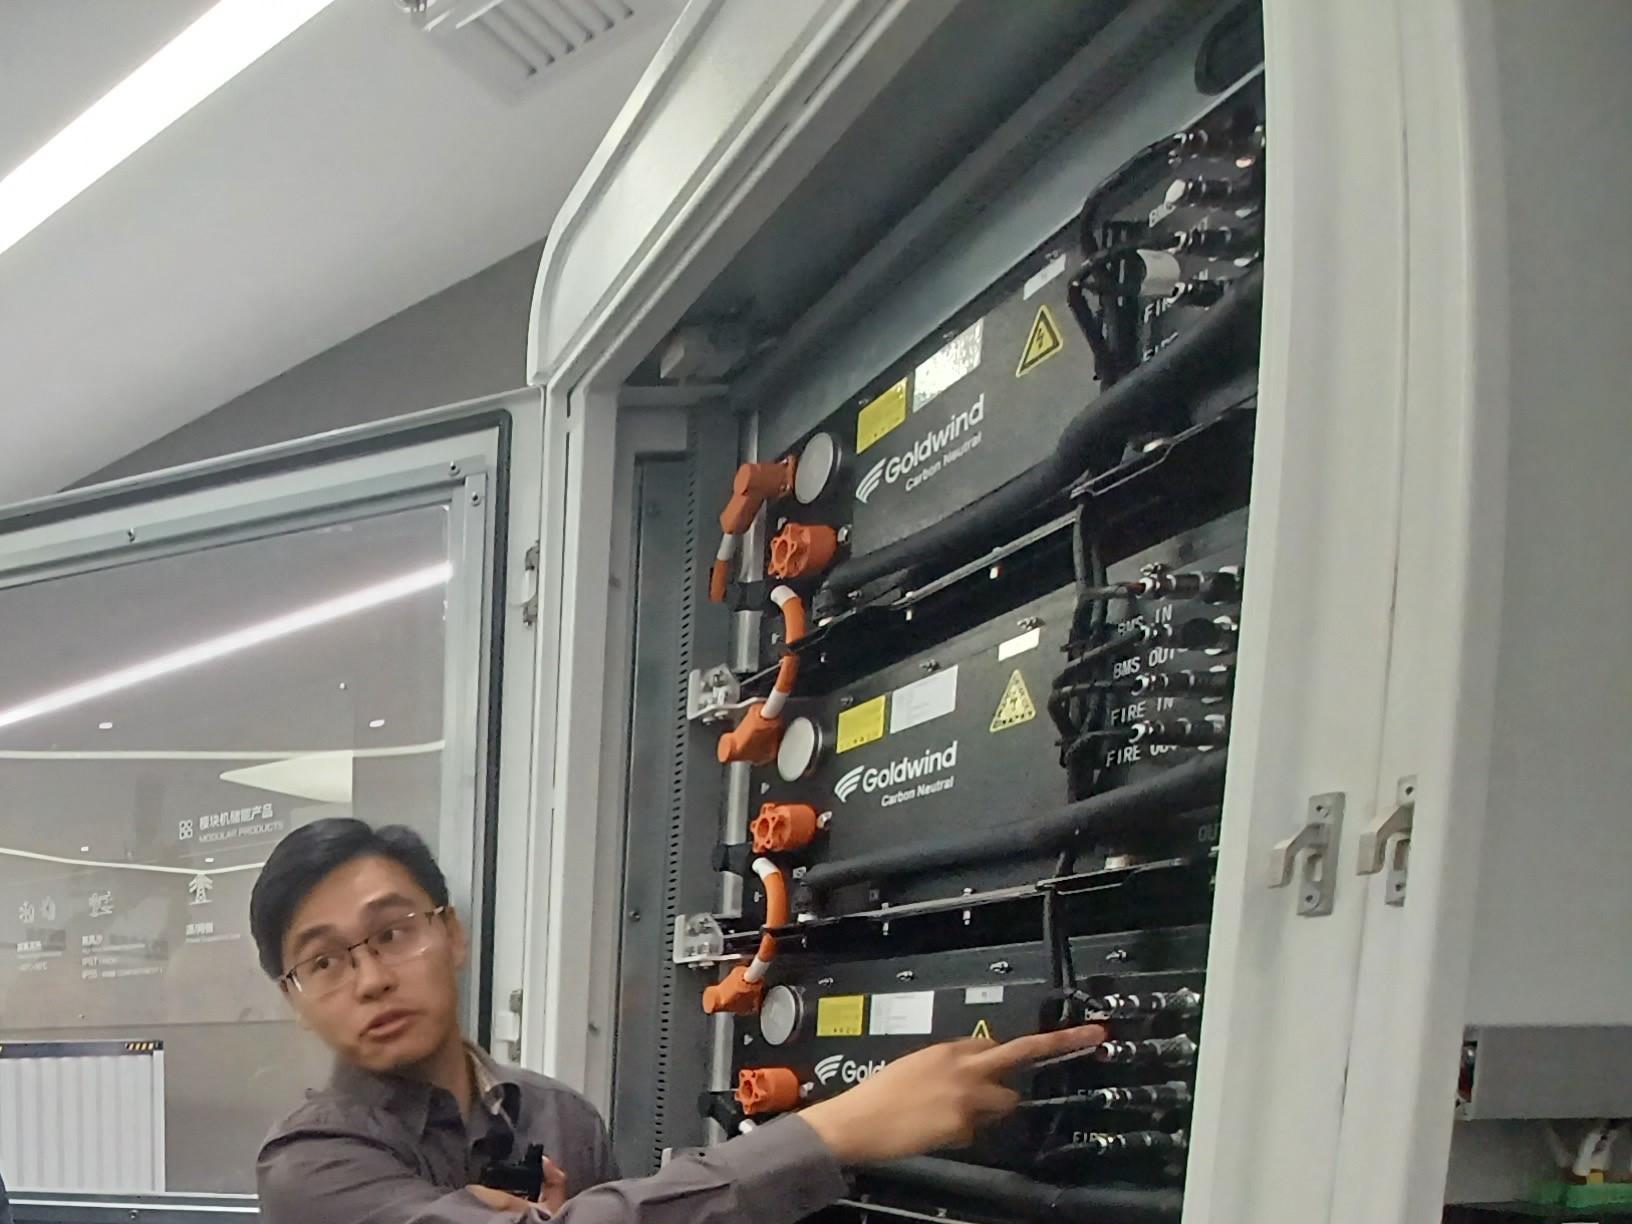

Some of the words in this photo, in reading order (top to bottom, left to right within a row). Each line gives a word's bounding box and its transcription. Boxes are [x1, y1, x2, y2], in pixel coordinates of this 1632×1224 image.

[885, 393, 985, 484] Goldwind
[905, 461, 942, 491] Carbon
[1155, 604, 1173, 624] IN
[1113, 656, 1141, 680] BMS
[1110, 700, 1147, 726] FIRE
[862, 740, 959, 793] Goldwind
[1105, 744, 1142, 768] FIRE
[881, 789, 916, 807] Carbon
[917, 775, 955, 797] Neutral
